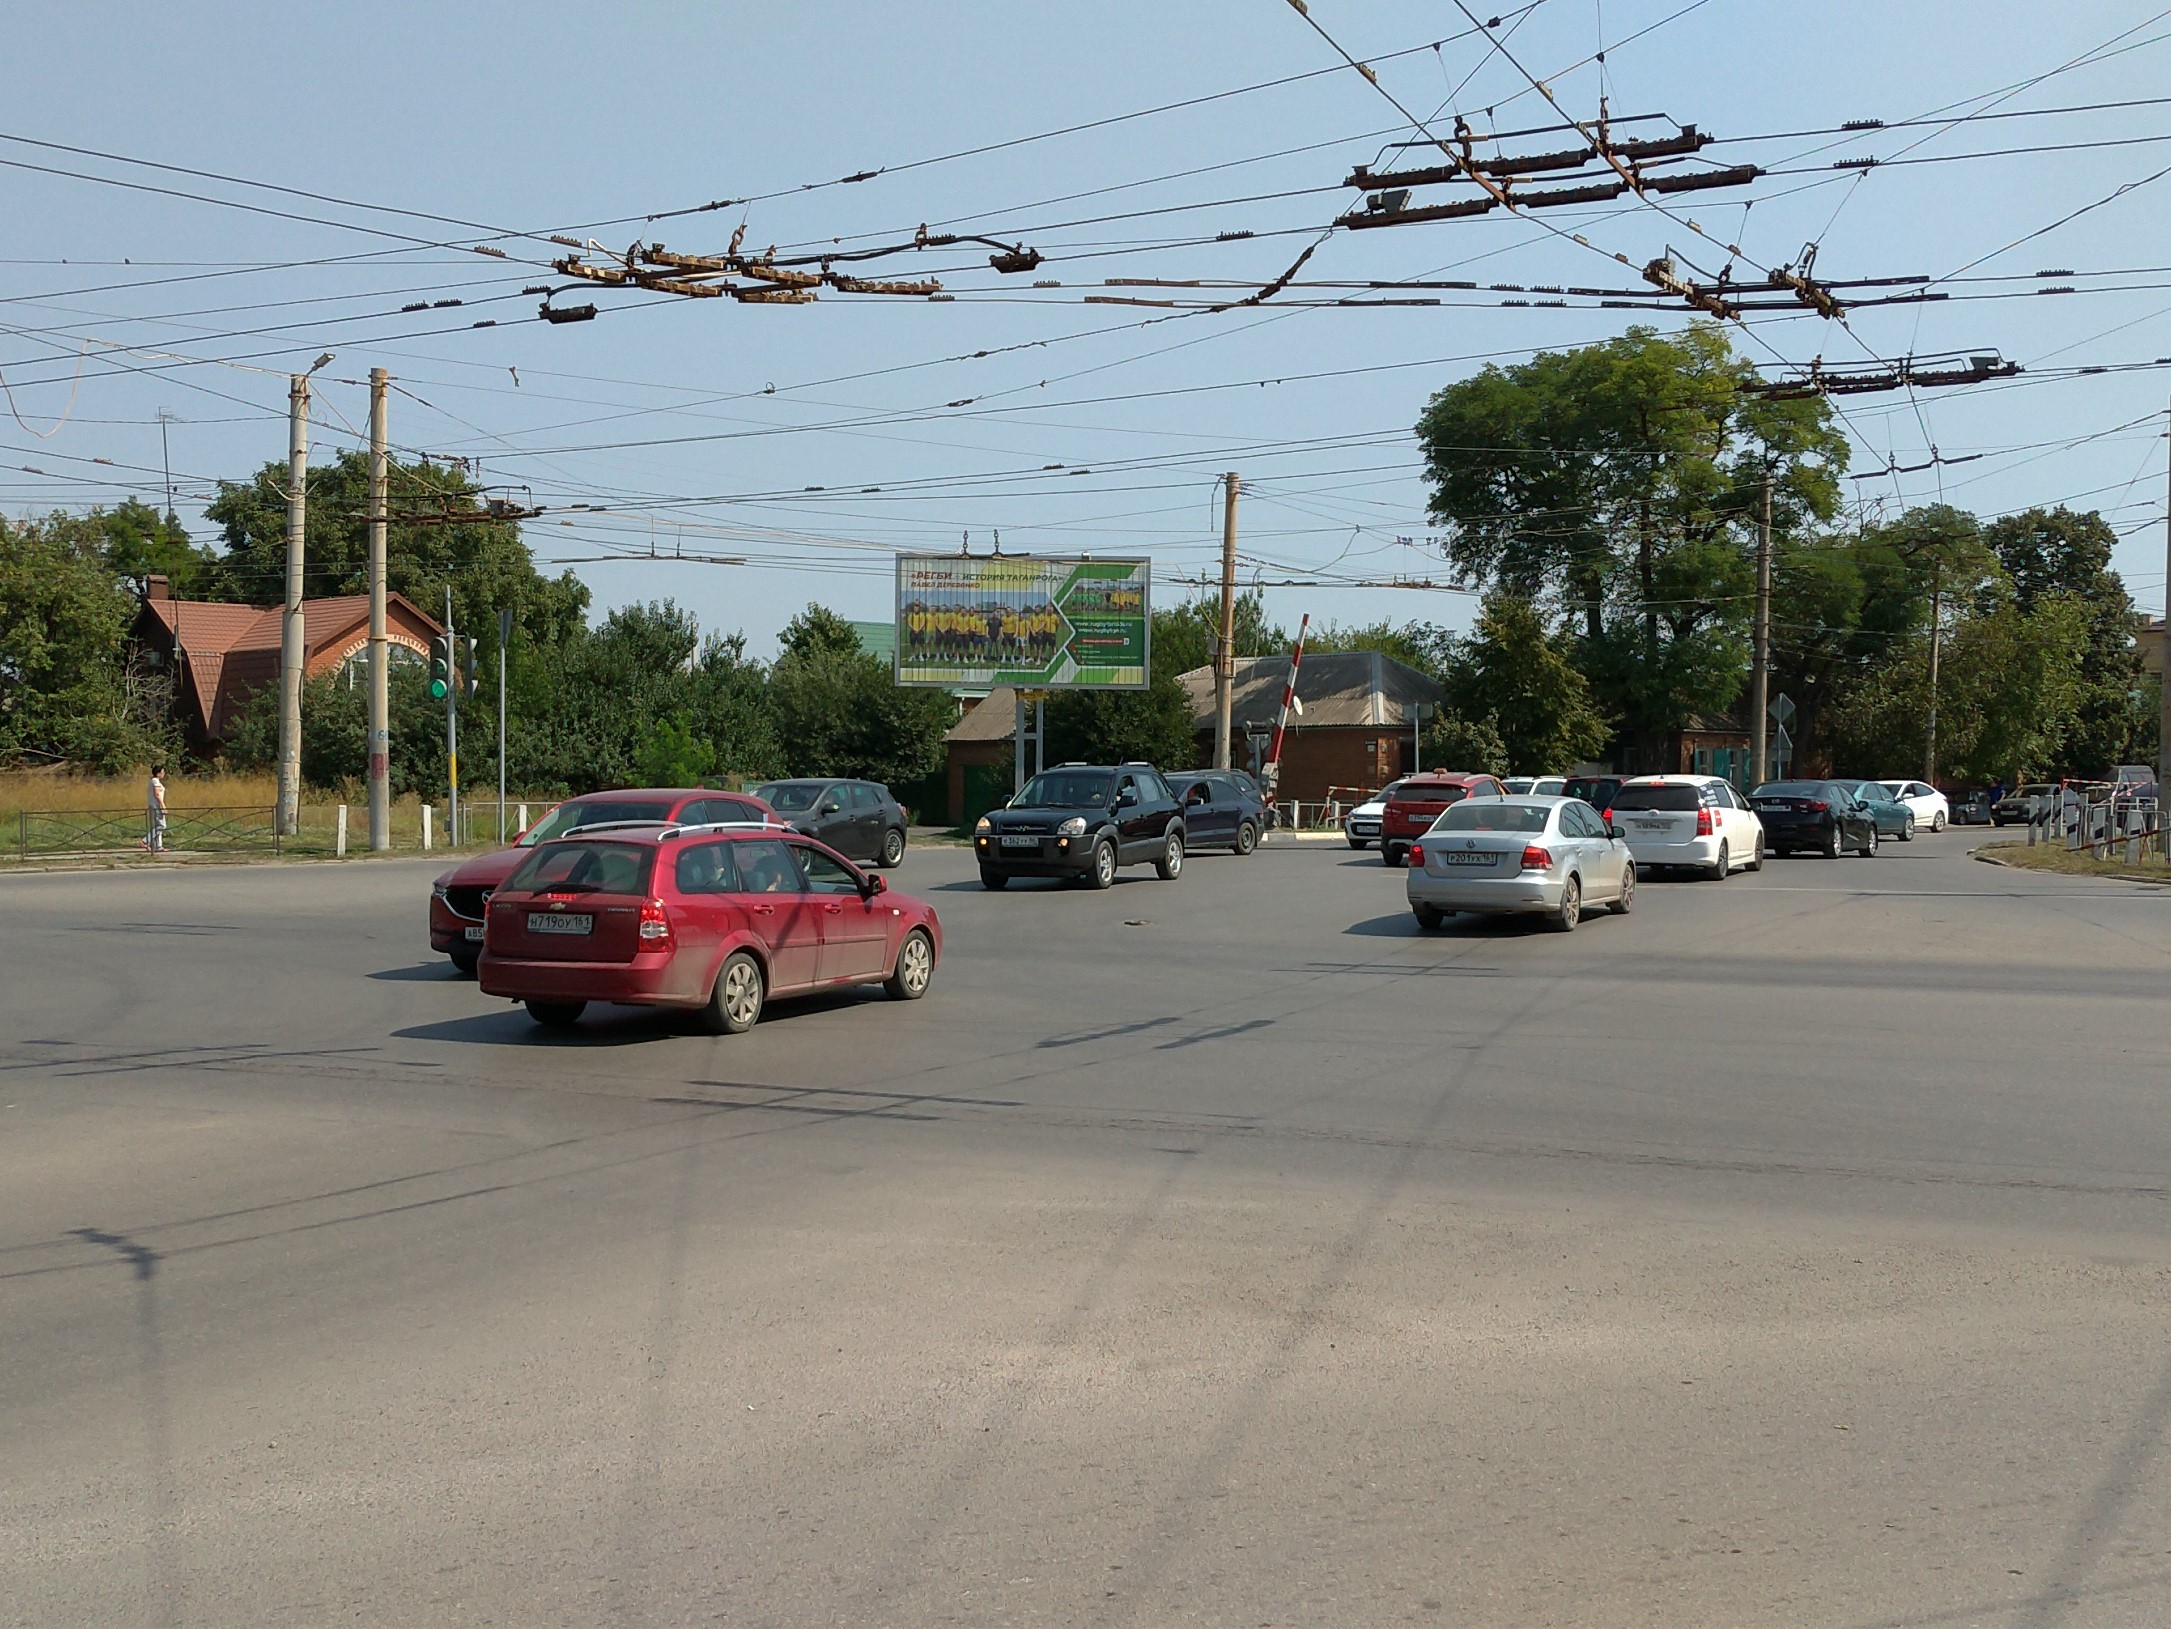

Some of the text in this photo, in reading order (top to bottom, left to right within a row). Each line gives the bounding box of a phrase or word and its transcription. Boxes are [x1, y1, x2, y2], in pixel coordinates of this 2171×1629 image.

[911, 571, 1063, 582] «РЕГБИ ИСТОРИЯ ТАГАНРОГА»
[530, 915, 590, 928] Н719ОУ 161
[467, 928, 484, 938] А85
